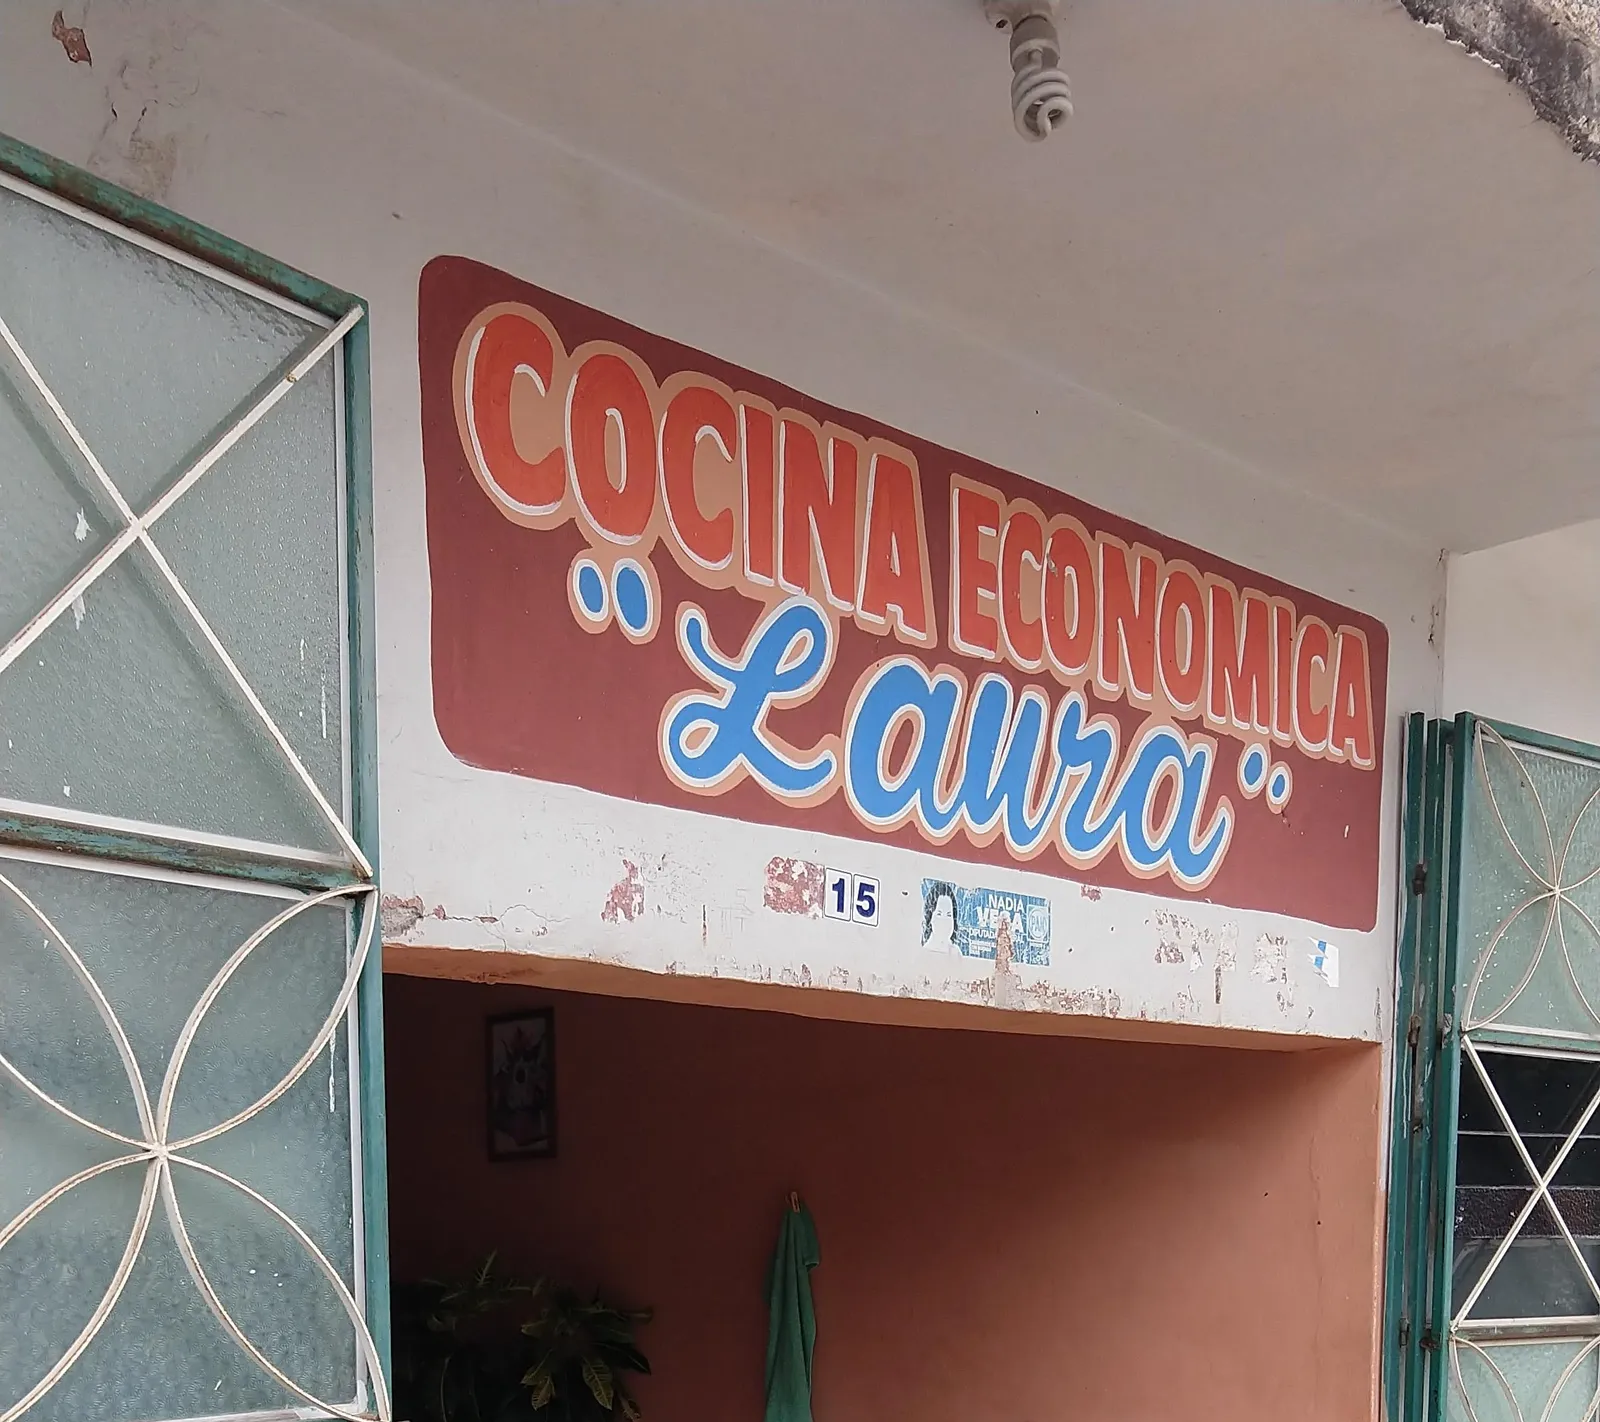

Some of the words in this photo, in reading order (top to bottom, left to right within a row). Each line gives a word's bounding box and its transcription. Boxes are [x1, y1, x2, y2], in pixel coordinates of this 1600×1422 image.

[463, 311, 929, 643] COCINA
[951, 486, 1372, 766] ECONOMICA
[662, 595, 1231, 886] Laura
[831, 877, 877, 918] 15
[988, 894, 1024, 913] NADIA
